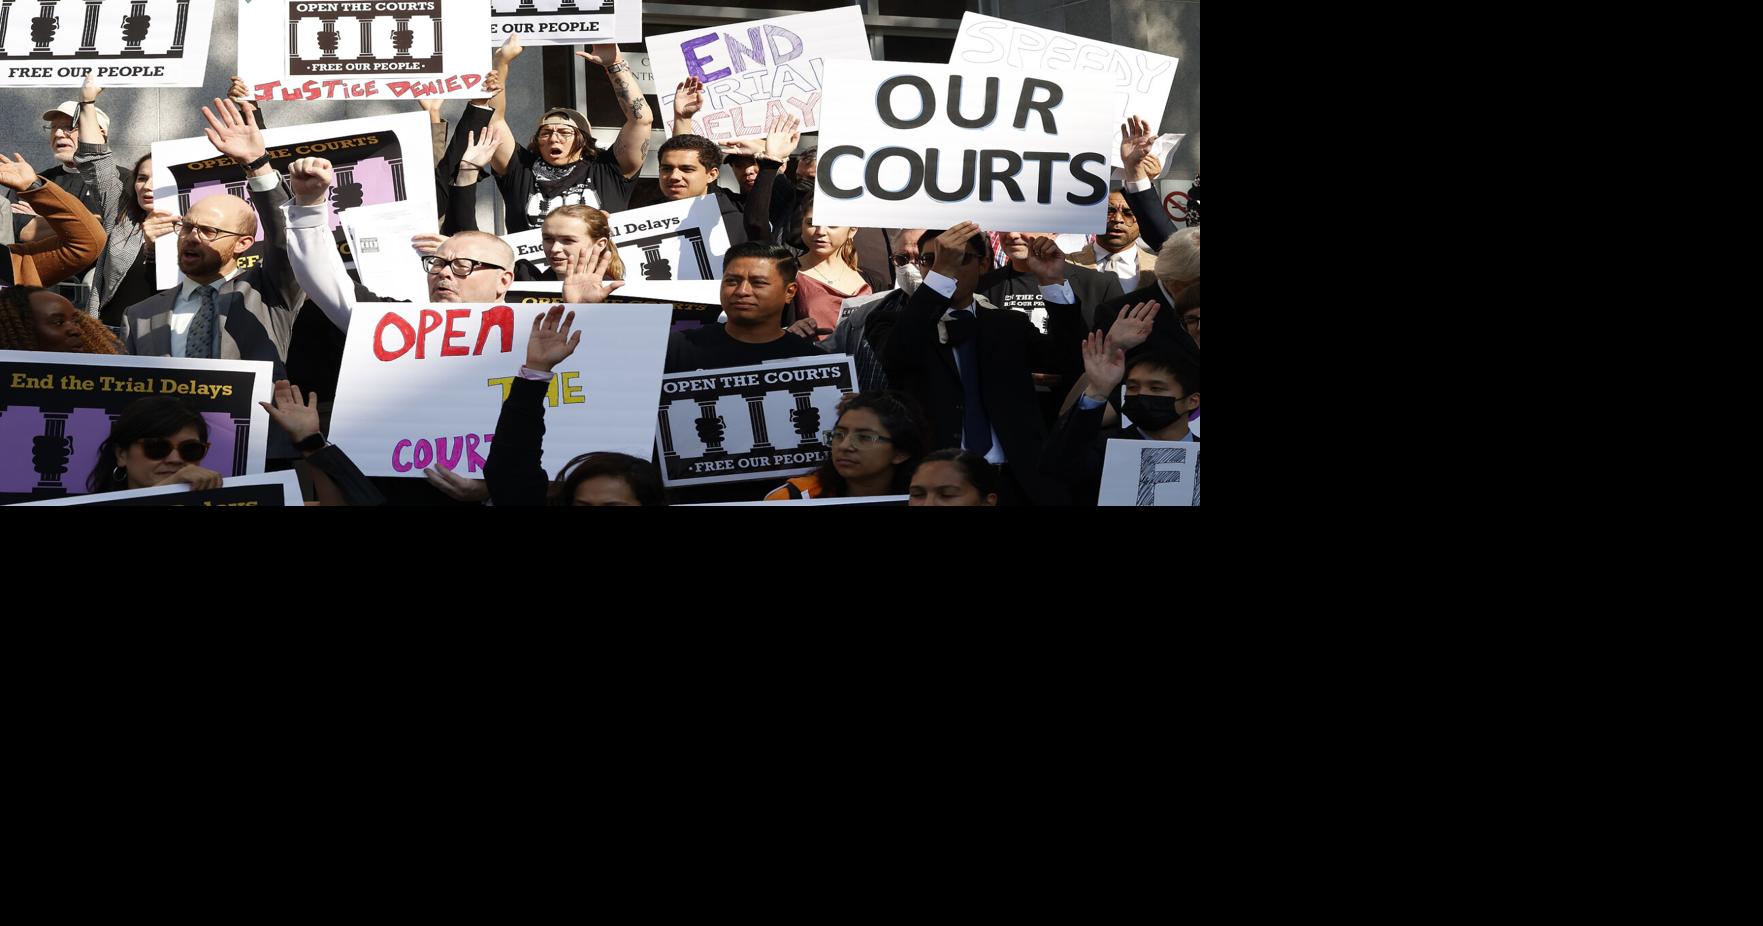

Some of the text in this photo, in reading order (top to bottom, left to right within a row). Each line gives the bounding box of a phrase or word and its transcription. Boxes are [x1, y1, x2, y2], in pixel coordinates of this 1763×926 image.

[296, 1, 436, 13] OPEN THE COURTS
[502, 22, 535, 33] OUR
[539, 21, 600, 33] PEOPLE
[680, 23, 804, 84] END
[961, 20, 1171, 94] SPEEDY
[8, 66, 165, 78] FREE OUR PEOPLE
[312, 61, 422, 72] FREE OUR PEOPLE
[874, 74, 1064, 135] OUR
[295, 135, 379, 155] COURTS
[816, 144, 1108, 206] COURTS
[624, 216, 680, 235] Delays
[10, 373, 234, 399] End the Trial Delays
[662, 366, 842, 395] OPEN THE COURTS
[694, 459, 735, 473] FREE
[737, 455, 770, 469] OUR
